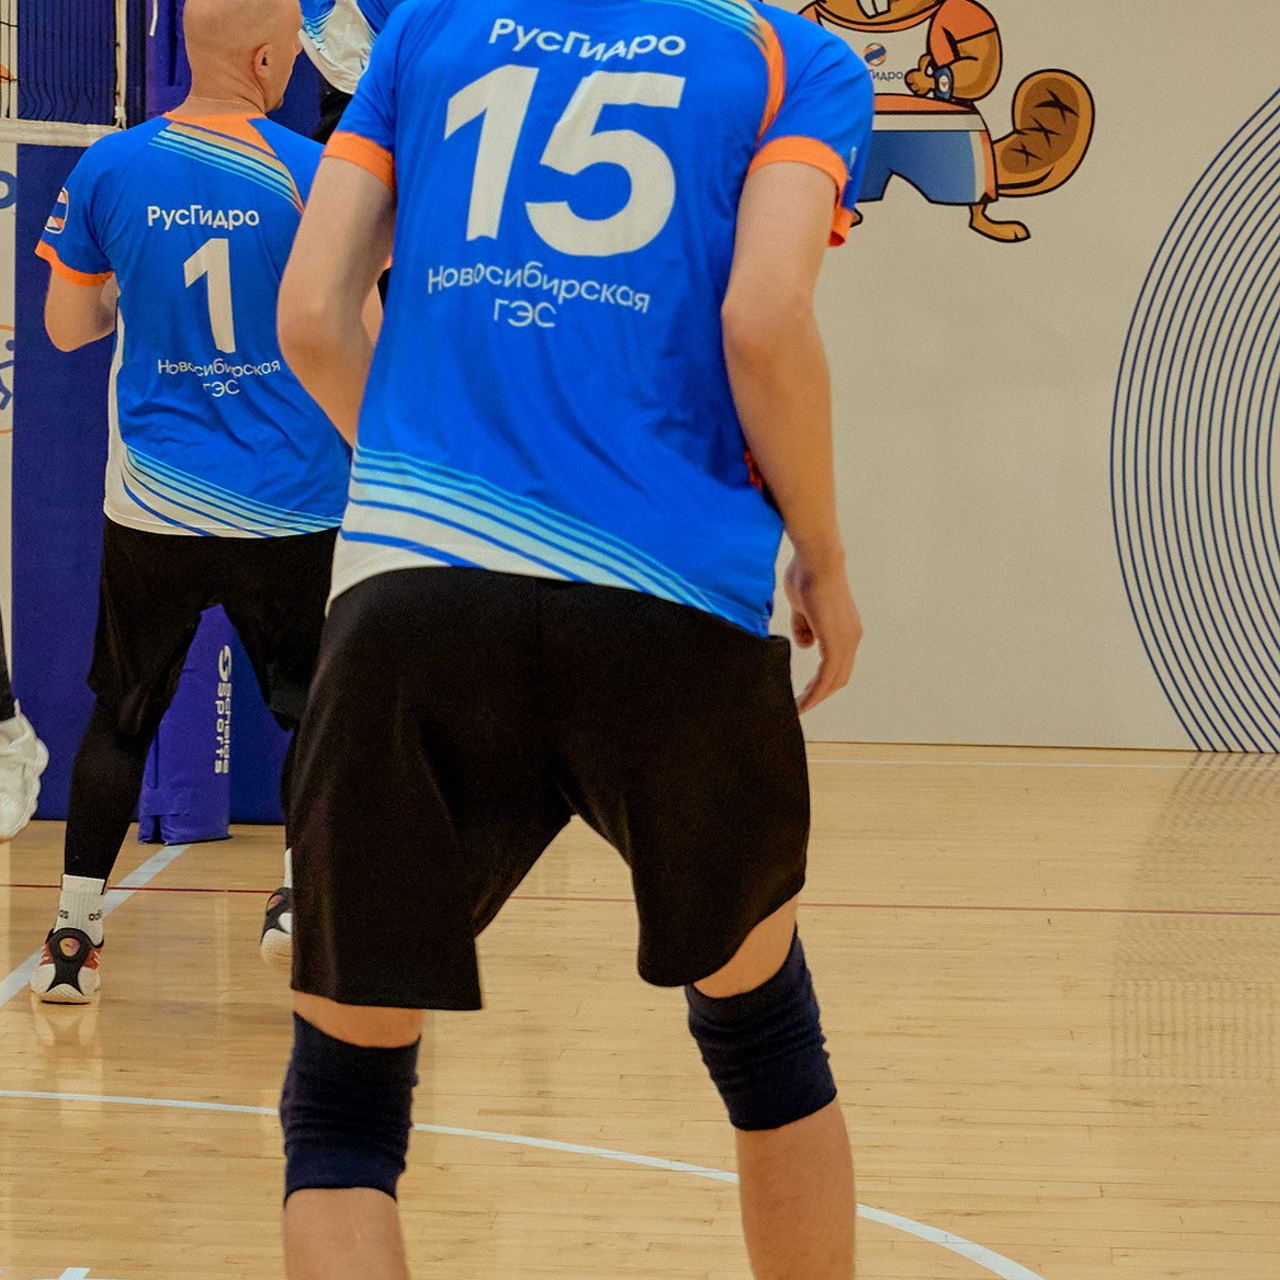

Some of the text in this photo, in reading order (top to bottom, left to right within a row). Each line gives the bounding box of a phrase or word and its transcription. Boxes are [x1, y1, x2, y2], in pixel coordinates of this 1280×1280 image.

[488, 18, 687, 61] РусГидро
[444, 63, 687, 257] 15
[147, 204, 260, 231] РусГидро
[183, 238, 236, 354] 1
[426, 260, 651, 314] Новосибирская
[493, 298, 557, 328] ГЭС
